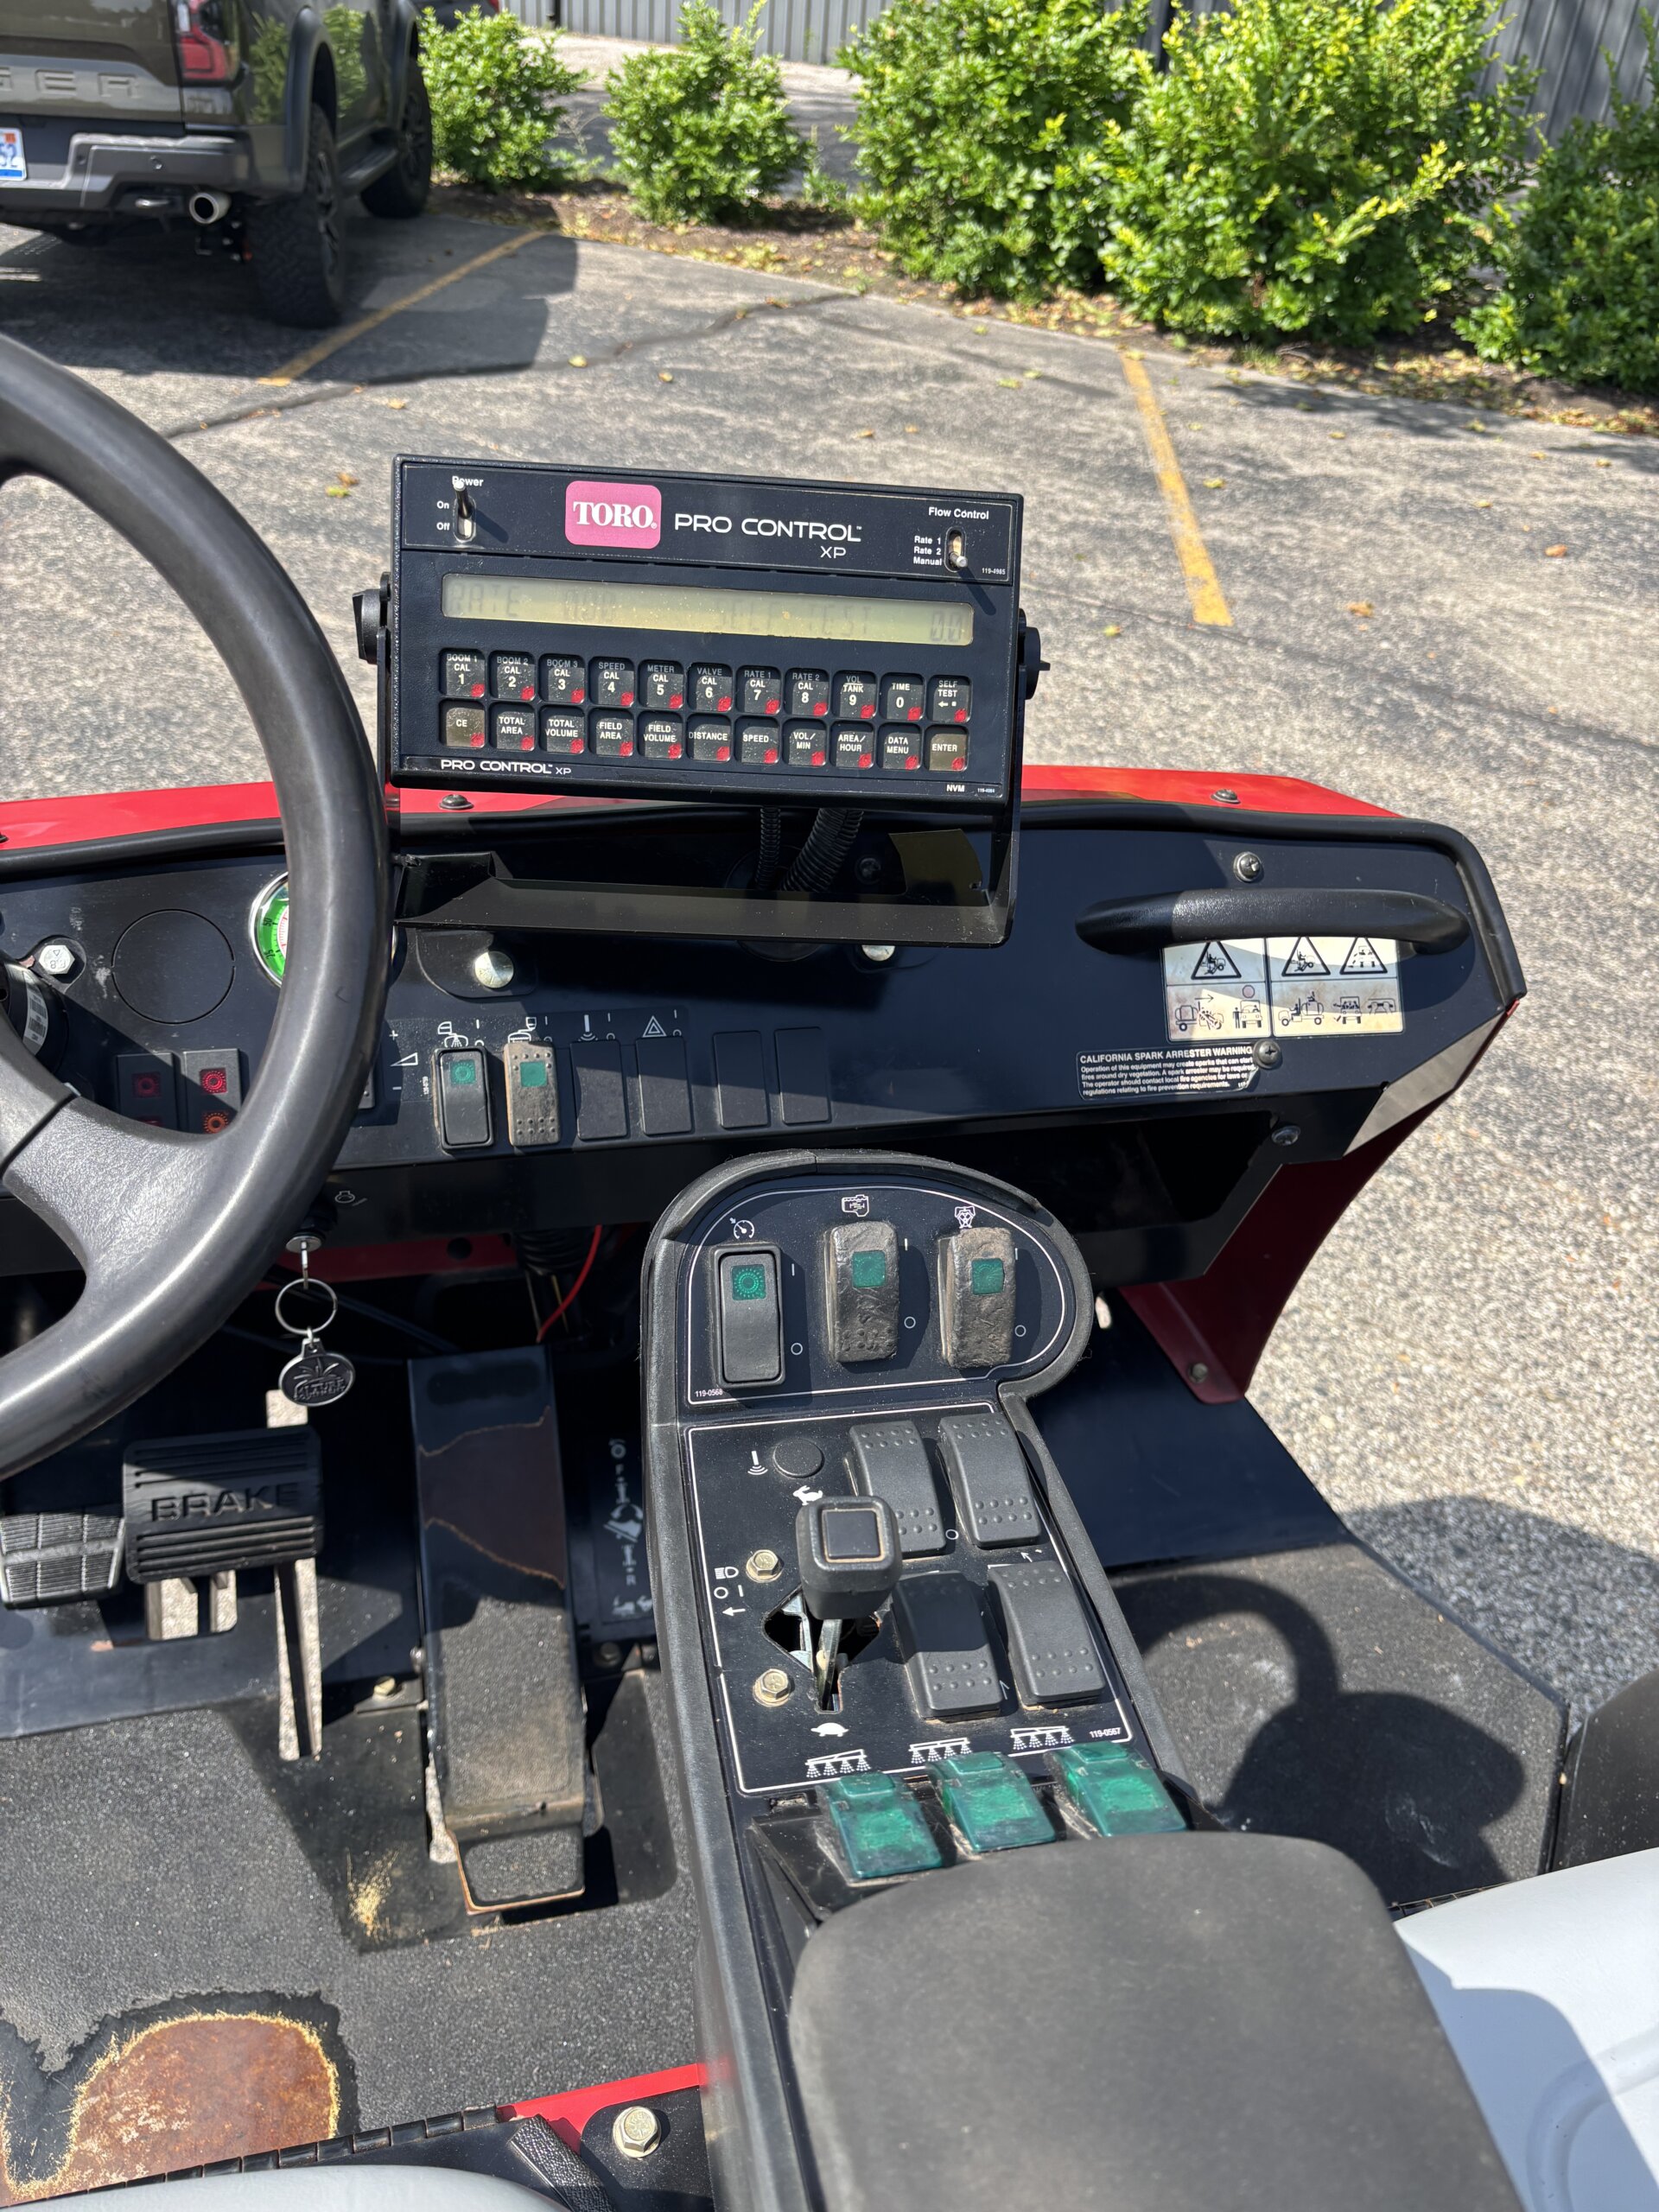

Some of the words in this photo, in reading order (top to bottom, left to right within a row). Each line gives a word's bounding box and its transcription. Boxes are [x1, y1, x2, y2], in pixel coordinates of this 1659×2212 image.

[436, 500, 450, 510] On
[572, 501, 655, 529] TORO
[928, 506, 951, 518] Flow
[953, 508, 989, 519] Control
[436, 521, 450, 531] Off
[674, 512, 733, 533] PRO
[914, 535, 933, 544] Rate
[820, 545, 847, 559] XP
[913, 546, 932, 555] Rate
[936, 547, 942, 556] 2
[912, 556, 943, 566] Manual
[446, 654, 471, 663] BOOM
[497, 656, 521, 664] BOOM
[546, 658, 570, 667] BOOM
[598, 662, 626, 671] SPEED
[647, 664, 675, 673] METER
[554, 669, 570, 677] CAL
[603, 671, 620, 680] CAL
[696, 667, 722, 676] VALVE
[744, 670, 766, 678] RATE
[458, 674, 465, 685] 1
[652, 674, 669, 683] CAL
[701, 677, 717, 685] CAL
[792, 672, 815, 681] RATE
[846, 675, 861, 683] VOL
[508, 676, 517, 688] 2
[557, 678, 566, 690] 3
[749, 679, 766, 688] CAL
[798, 682, 814, 690] CAL
[938, 680, 958, 689] SELF
[607, 681, 616, 693] 4
[657, 684, 664, 696] 5
[842, 684, 864, 693] TANK
[892, 683, 911, 691] TIME
[705, 687, 713, 698] 6
[753, 690, 762, 701] 7
[938, 689, 958, 697] TEST
[801, 692, 810, 703] 8
[849, 694, 857, 706] 9
[895, 696, 905, 709] 0
[455, 719, 467, 728] CE
[499, 716, 524, 726] TOTAL
[549, 719, 575, 728] TOTAL
[599, 721, 622, 730] FIELD
[545, 728, 578, 737] VOLUME
[648, 724, 671, 733] FIELD
[600, 731, 622, 740] AREA
[643, 734, 676, 743] VOLUME
[689, 732, 728, 741] DISTANCE
[742, 734, 769, 743] SPEED
[793, 732, 817, 741] VOL/
[838, 734, 866, 743] AREA/
[887, 736, 909, 745] DATA
[796, 741, 811, 750] MIN
[839, 744, 862, 753] HOUR
[887, 746, 909, 754] MENU
[931, 744, 957, 753] ENTER
[441, 759, 475, 771] PRO
[946, 784, 965, 792] NVM
[1079, 1052, 1133, 1064] CALIFORNIA
[1135, 1051, 1164, 1061] SPARK
[1166, 1048, 1211, 1058] ARRESTER
[1212, 1046, 1253, 1055] WARNING
[1081, 1065, 1109, 1073] Operation
[1195, 1058, 1215, 1067] sparks
[1117, 1071, 1128, 1080] dry
[1128, 1070, 1160, 1078] vegetation.
[1083, 1087, 1116, 1096] regulations
[1116, 1085, 1139, 1094] relating
[1158, 1082, 1189, 1092] prevention
[150, 1481, 299, 1522] BRAKE
